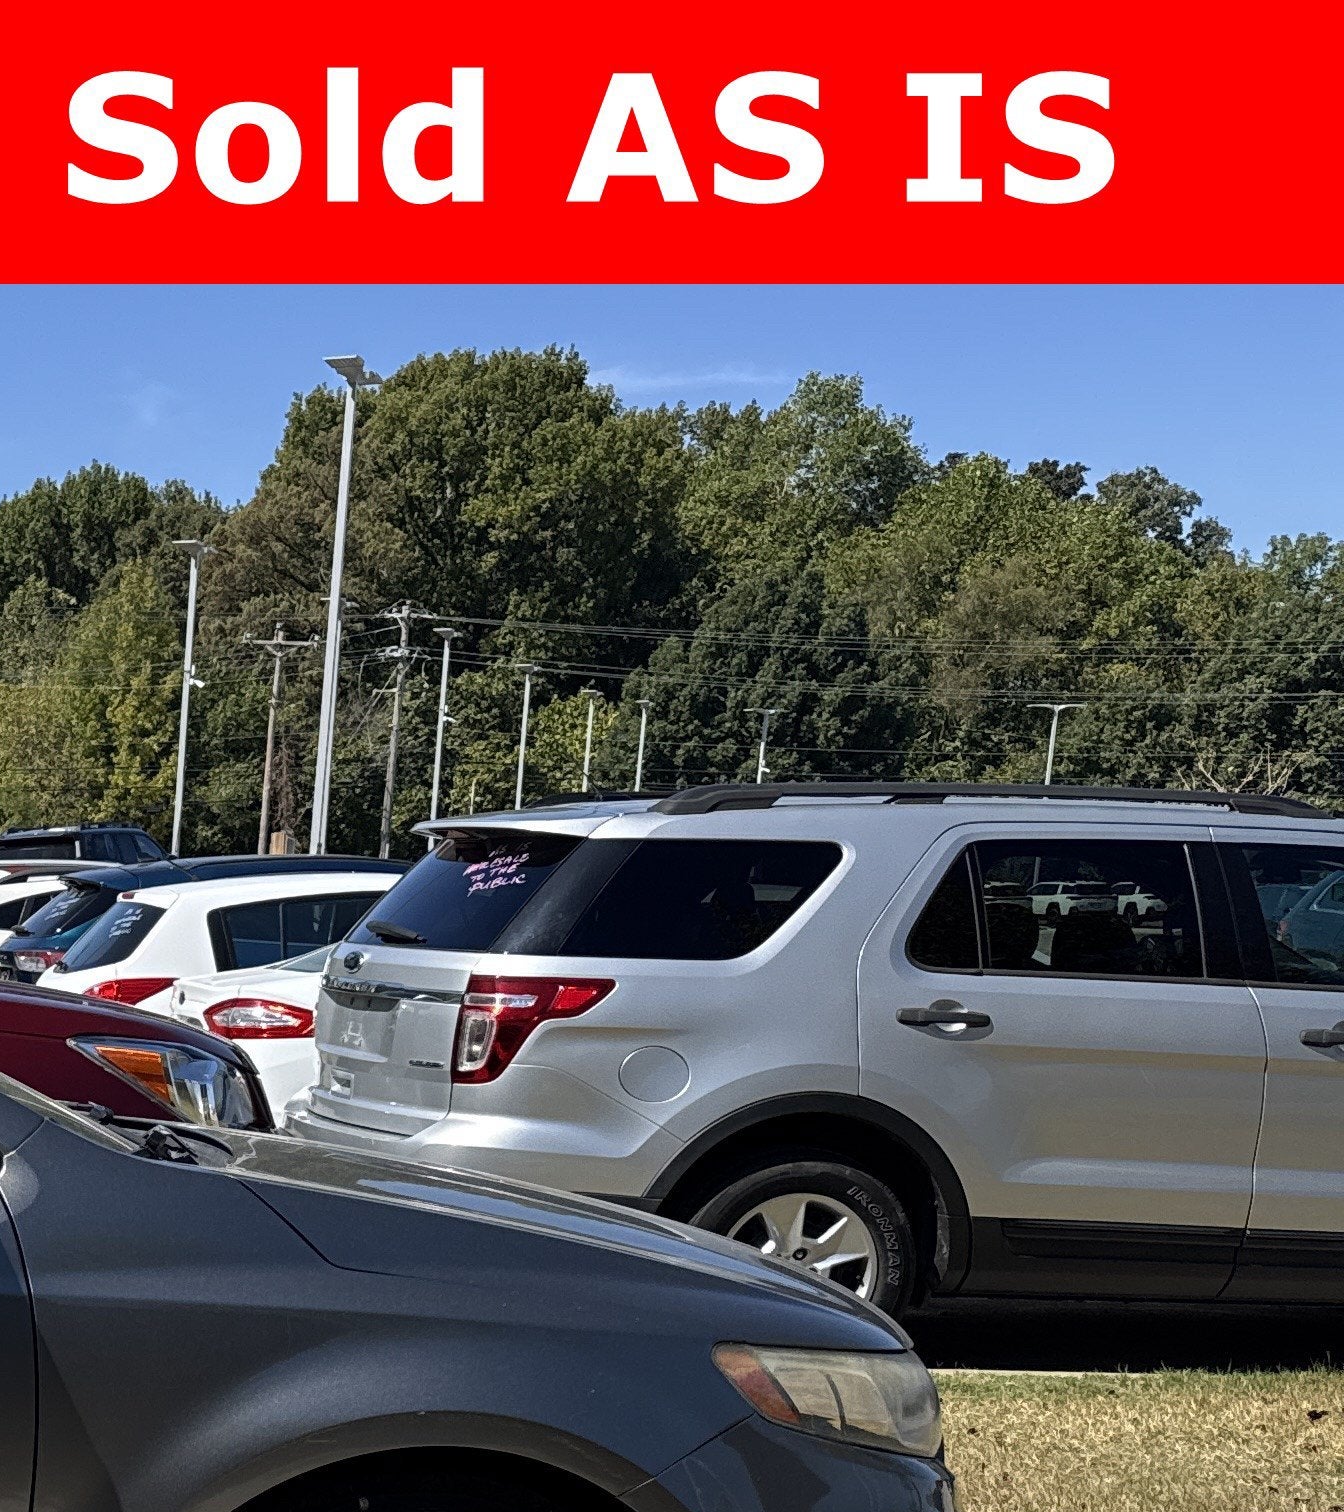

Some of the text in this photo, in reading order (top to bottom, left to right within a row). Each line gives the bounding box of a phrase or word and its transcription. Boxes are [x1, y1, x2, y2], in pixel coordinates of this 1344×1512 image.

[490, 863, 521, 877] THE
[466, 874, 526, 897] PUBLIC
[847, 1186, 900, 1285] IRONMAN
